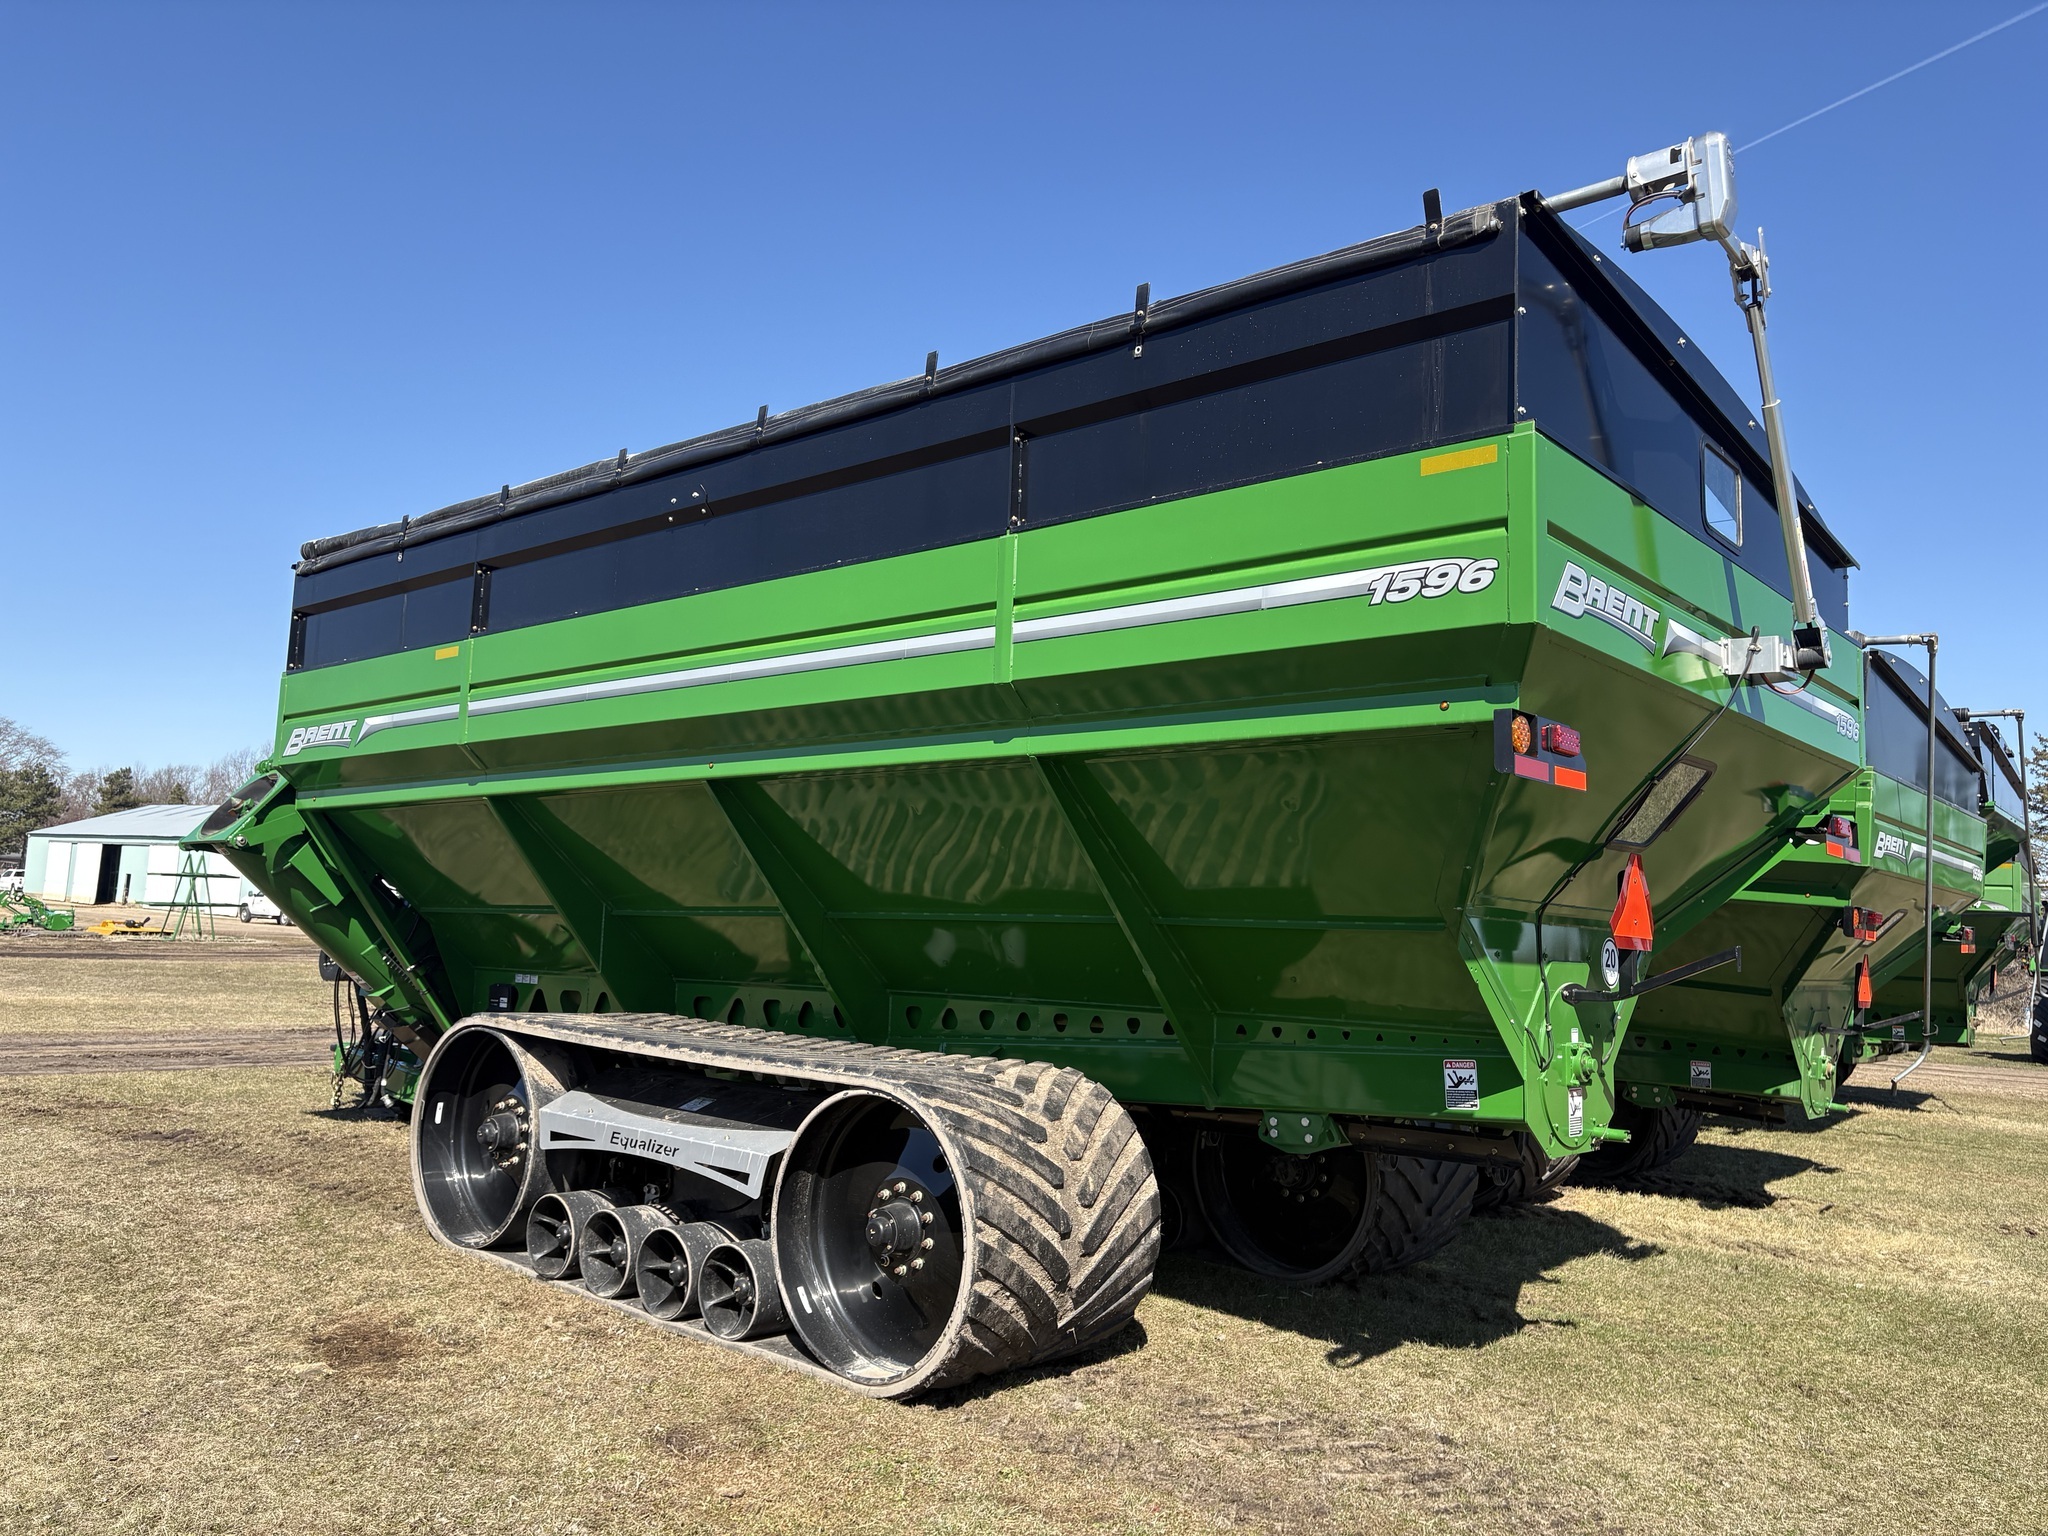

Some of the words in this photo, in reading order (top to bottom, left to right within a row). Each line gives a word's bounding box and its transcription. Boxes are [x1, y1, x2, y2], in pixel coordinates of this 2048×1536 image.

[1367, 558, 1500, 607] 1596
[1550, 560, 1661, 642] BRENT
[282, 719, 358, 757] BRENT
[1836, 712, 1860, 743] 1596
[1873, 831, 1909, 859] BRENT
[1605, 947, 1616, 969] 20
[609, 1130, 681, 1158] Equalizer
